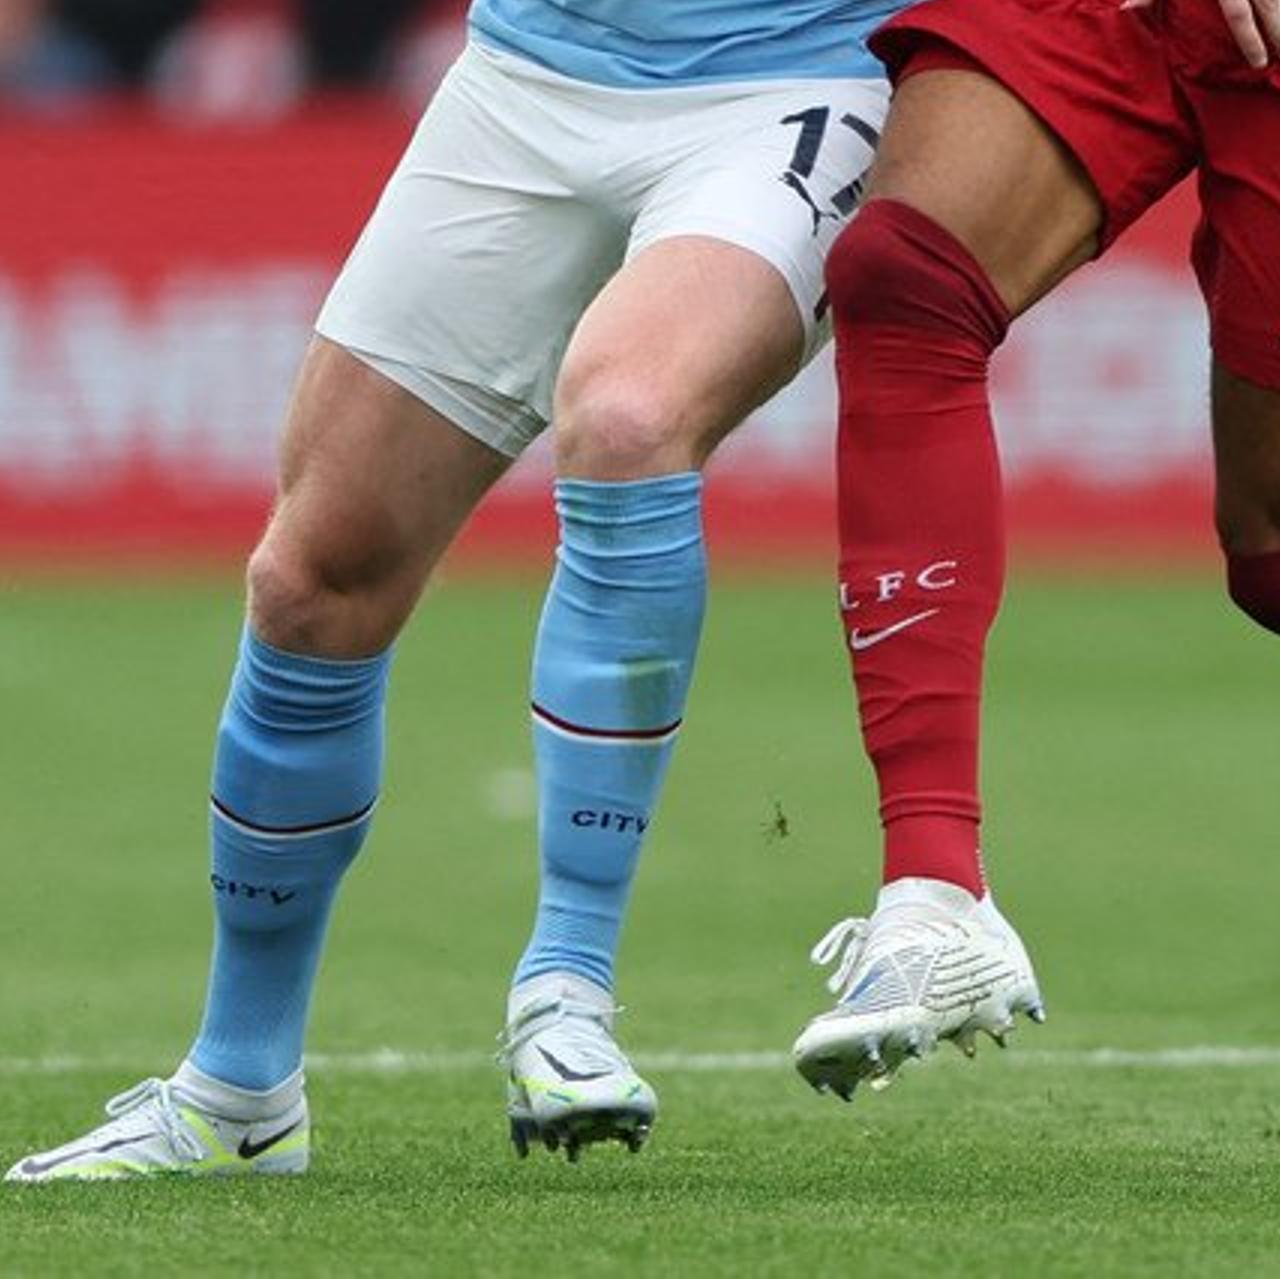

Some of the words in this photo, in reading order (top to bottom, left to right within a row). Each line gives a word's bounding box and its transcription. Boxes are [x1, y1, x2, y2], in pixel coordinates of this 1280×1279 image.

[780, 106, 880, 217] 17
[571, 810, 650, 834] CITY
[211, 873, 297, 905] CITY
